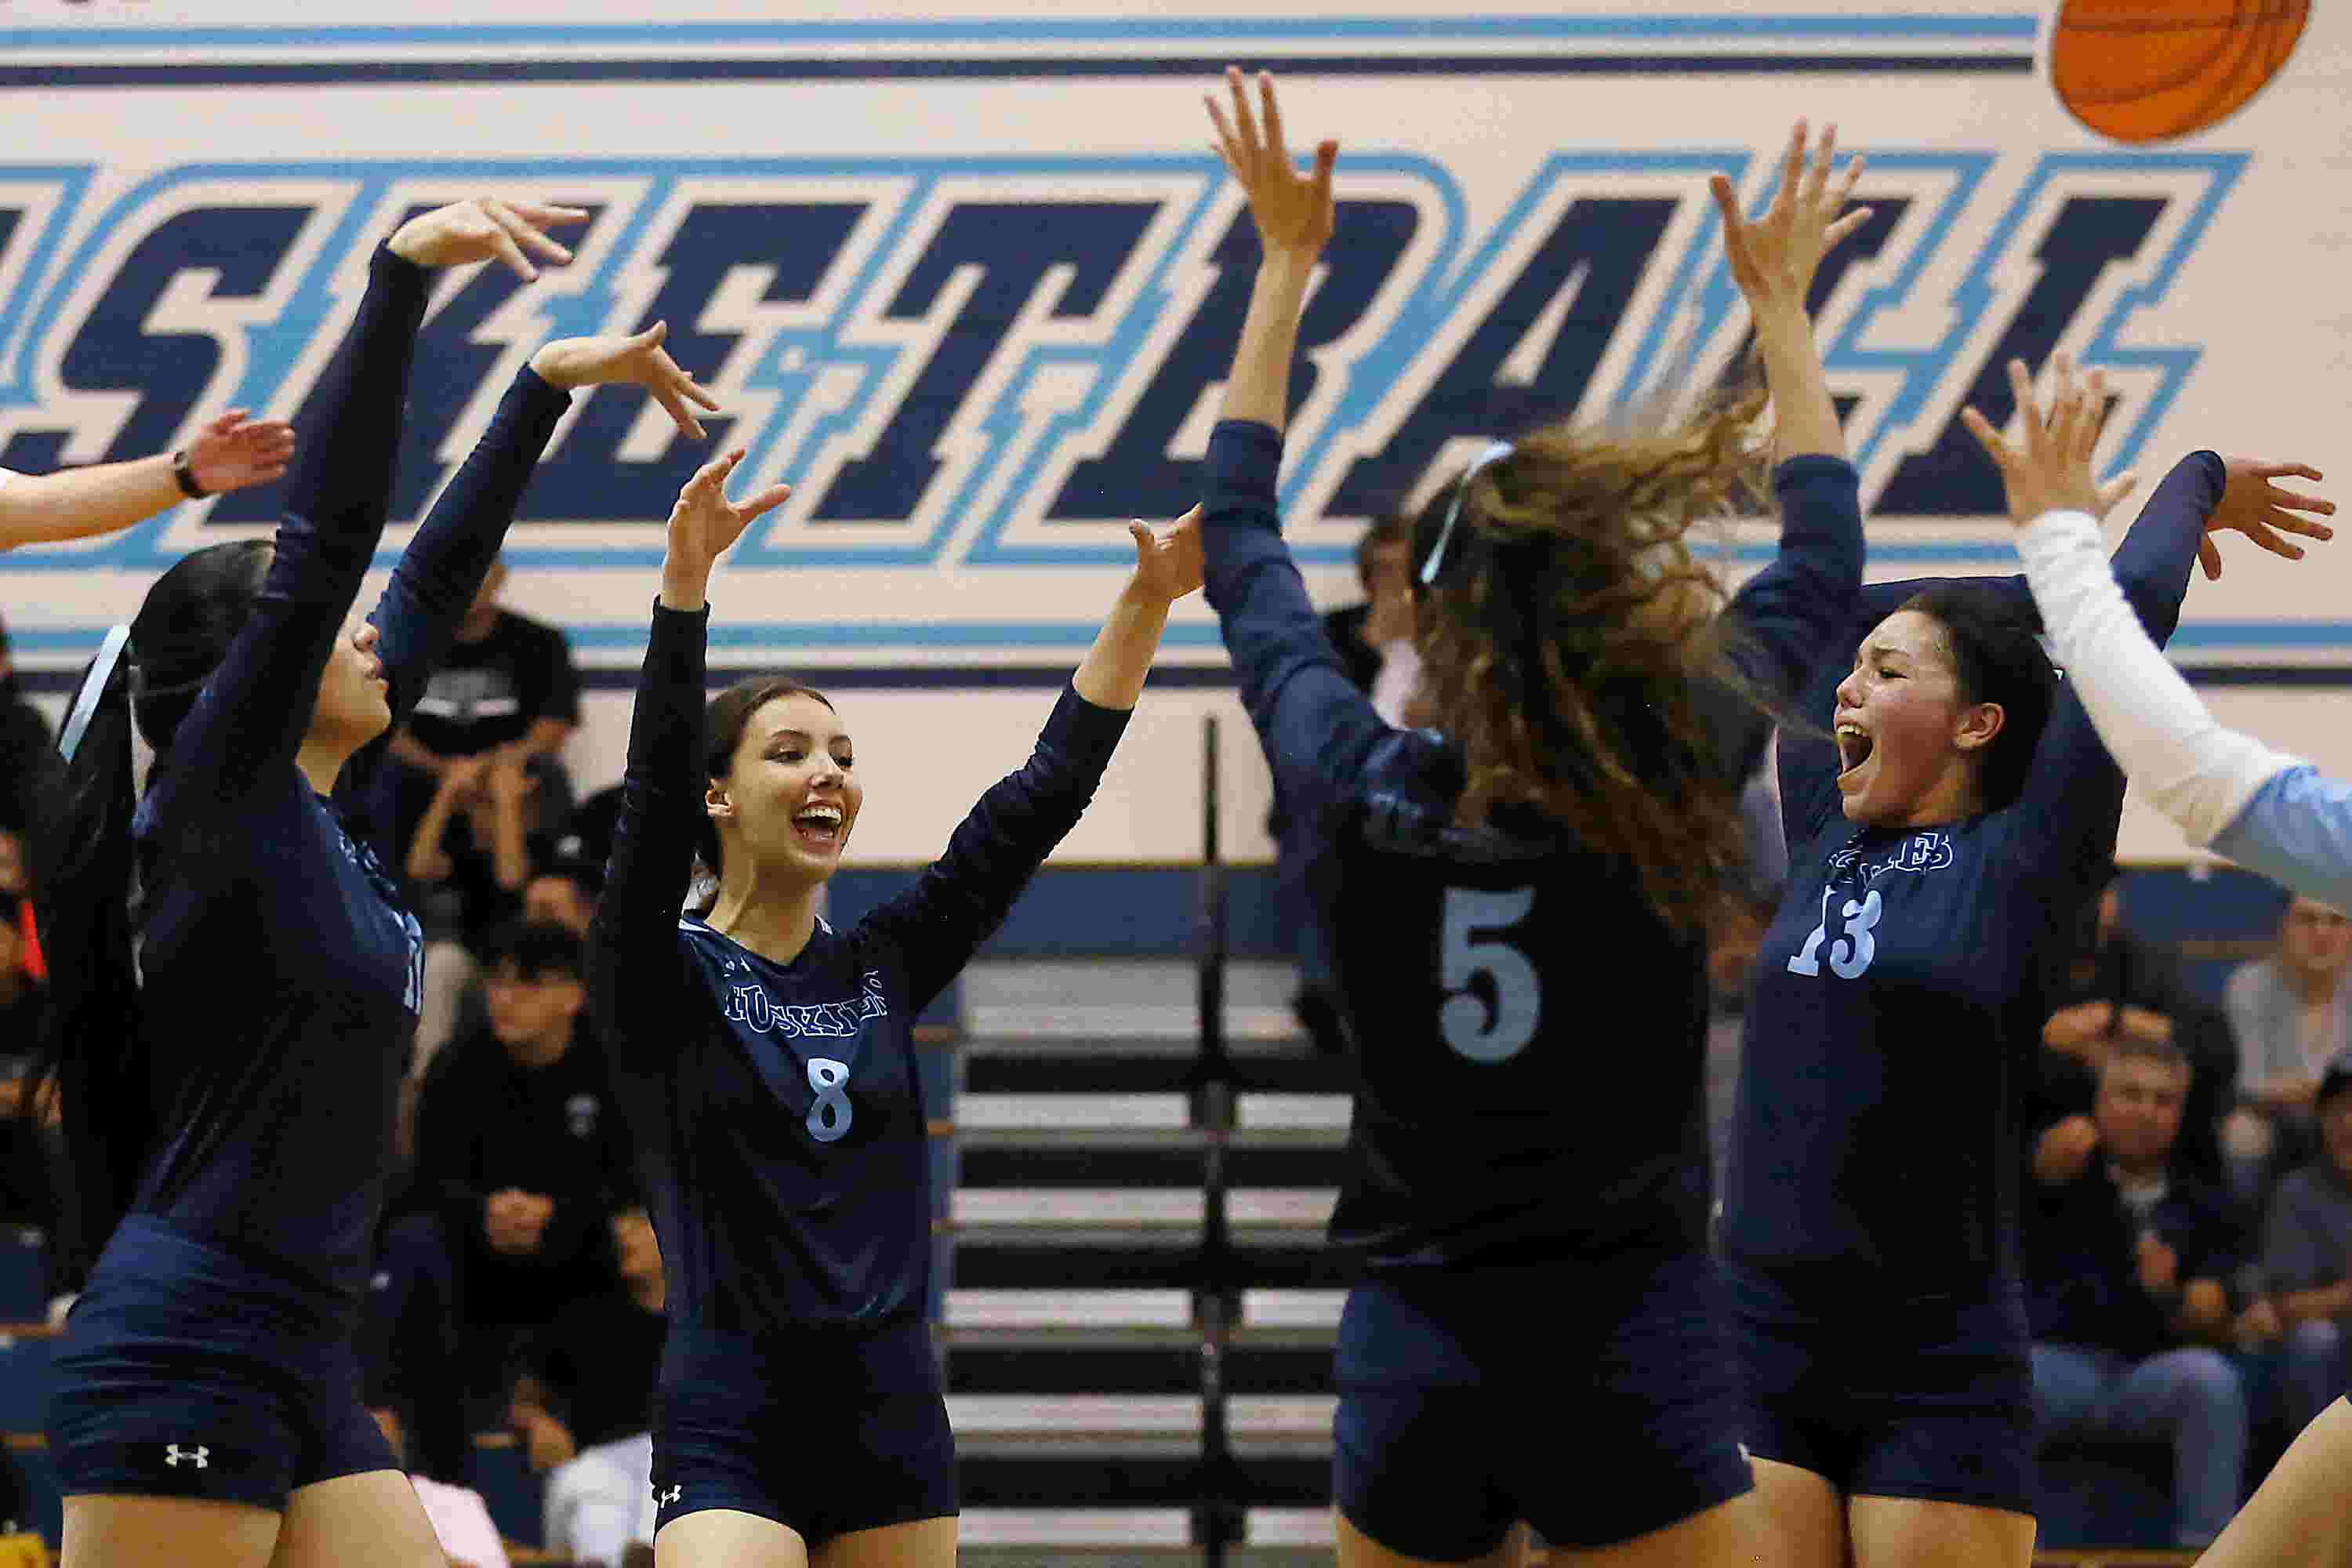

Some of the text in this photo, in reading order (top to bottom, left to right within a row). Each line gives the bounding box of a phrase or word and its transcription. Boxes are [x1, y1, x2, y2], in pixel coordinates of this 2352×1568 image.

[0, 151, 2250, 568] SKETBAL
[1439, 886, 1543, 1066] 5
[1787, 885, 1882, 979] 13
[805, 1058, 853, 1142] 8
